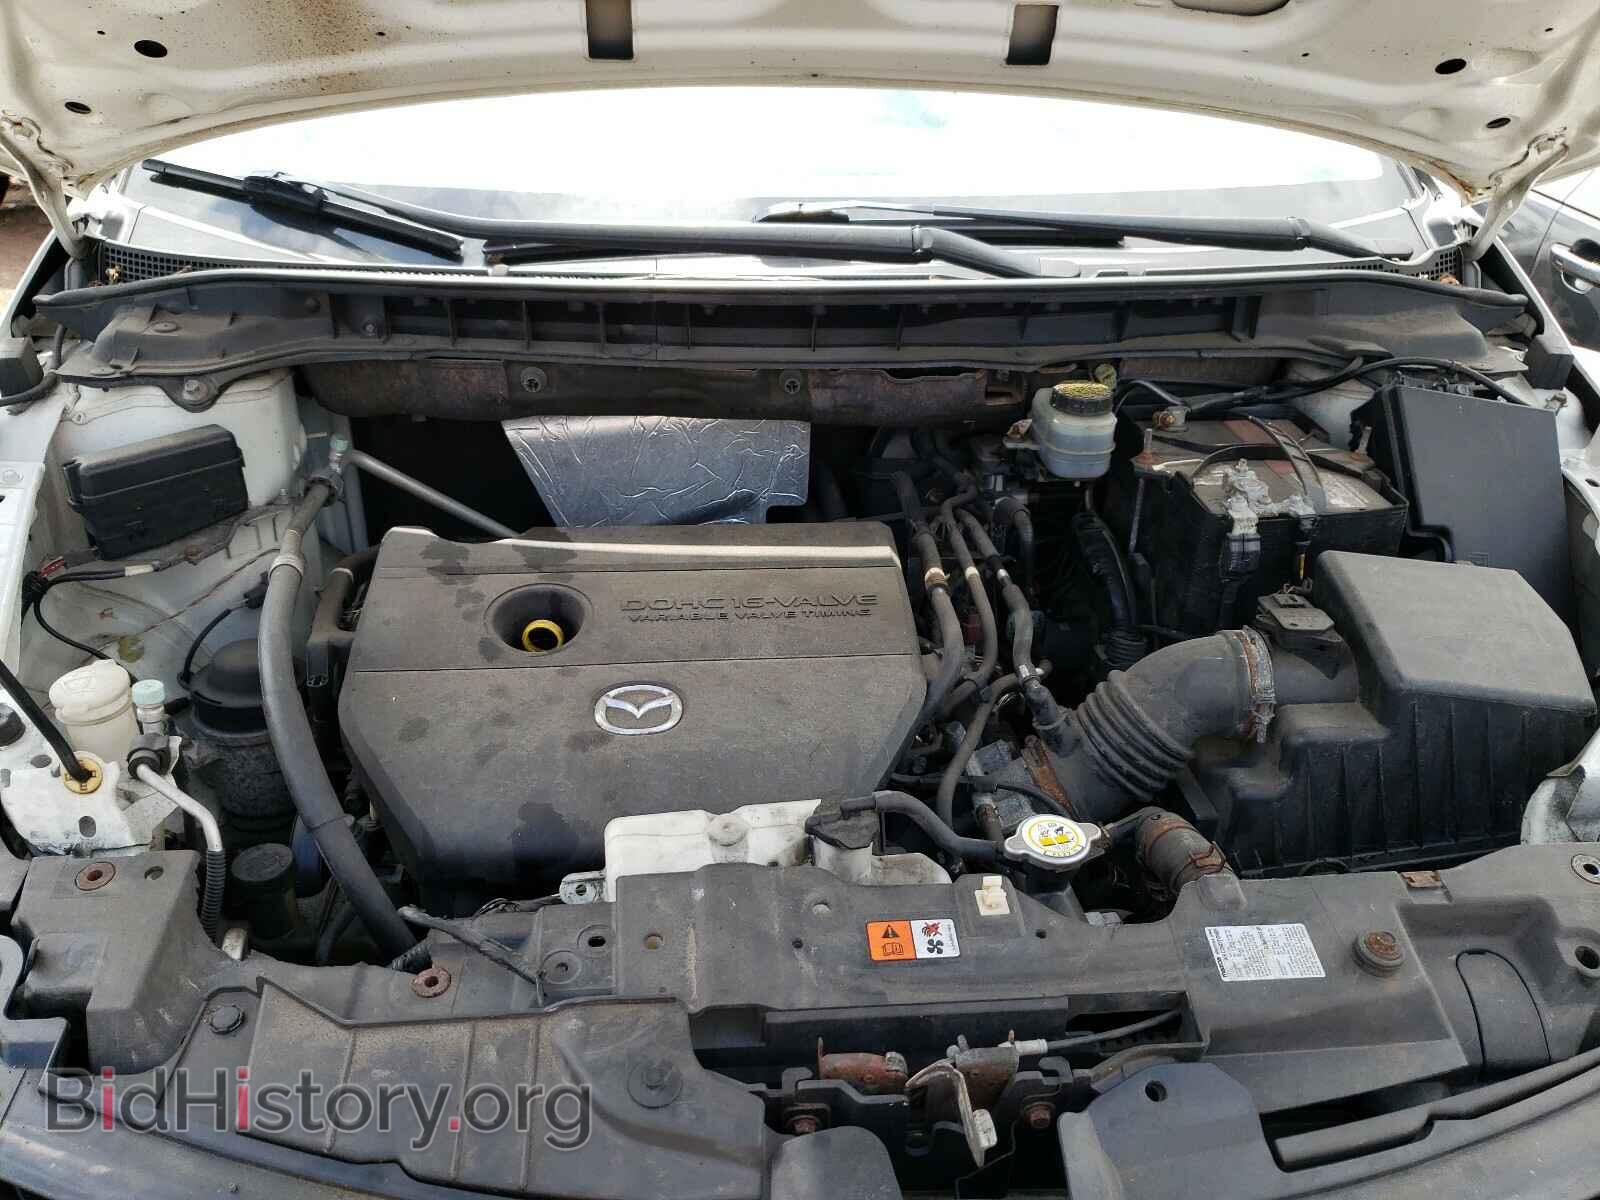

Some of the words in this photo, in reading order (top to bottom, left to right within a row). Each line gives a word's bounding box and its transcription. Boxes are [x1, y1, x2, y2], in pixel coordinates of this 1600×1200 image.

[621, 598, 726, 611] DOHC
[730, 594, 878, 609] 16-VALVE
[628, 612, 729, 622] VARIABLE
[735, 610, 797, 620] VALVE
[801, 608, 872, 619] TIMING
